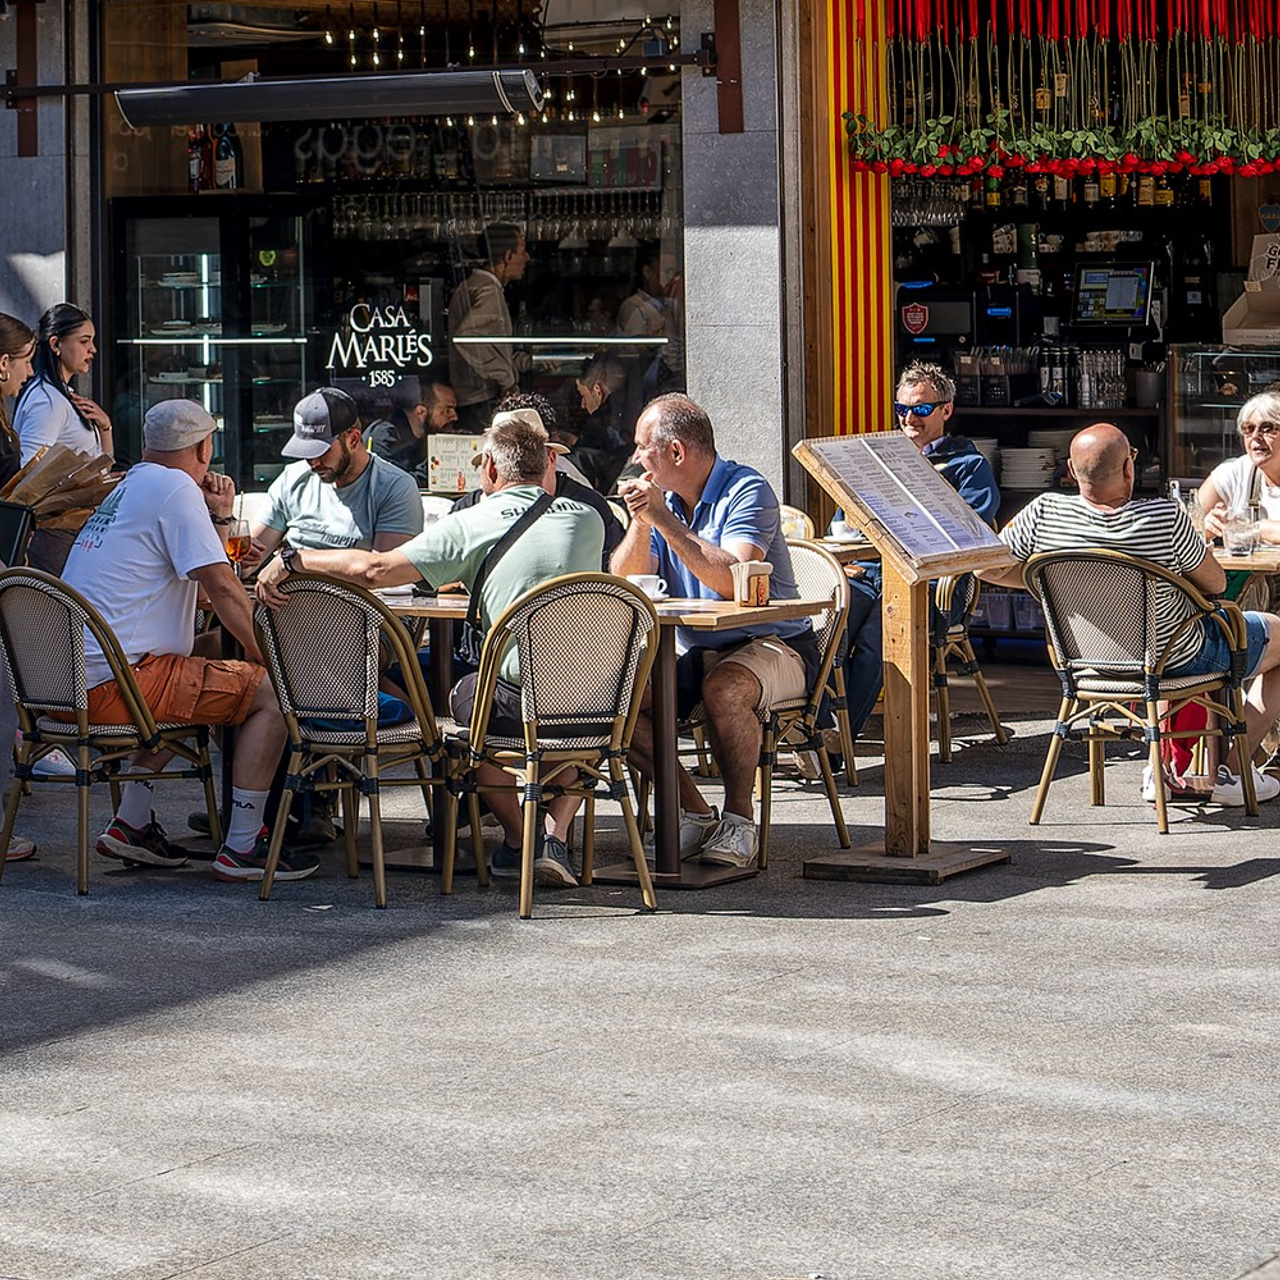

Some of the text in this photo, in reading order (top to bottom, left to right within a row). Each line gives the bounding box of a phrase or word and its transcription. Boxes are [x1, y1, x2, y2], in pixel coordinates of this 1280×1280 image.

[350, 303, 411, 333] CASA
[325, 328, 433, 369] MARLÉS
[369, 370, 396, 388] 1585
